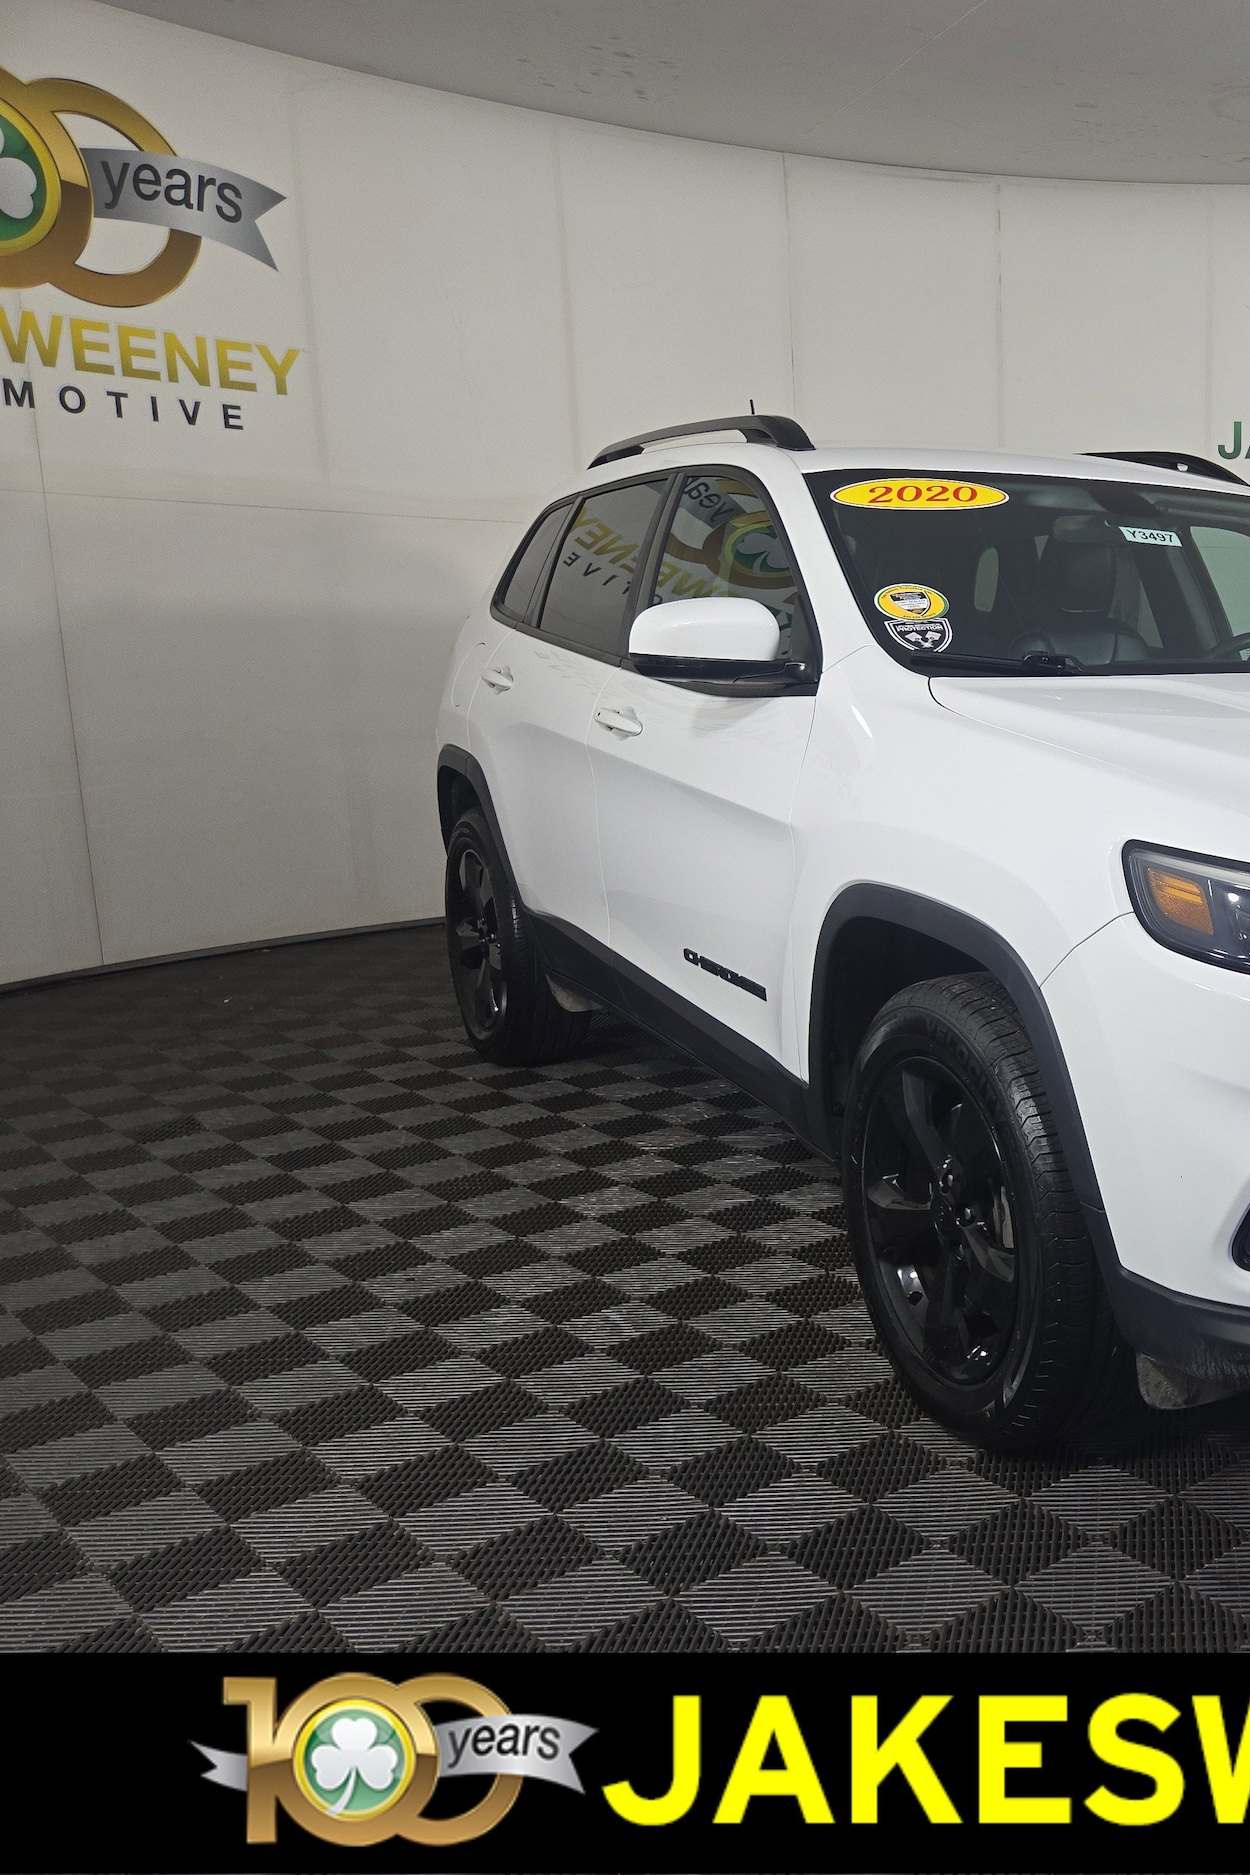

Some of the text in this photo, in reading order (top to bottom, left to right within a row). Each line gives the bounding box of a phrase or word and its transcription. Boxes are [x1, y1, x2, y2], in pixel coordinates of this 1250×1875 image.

[100, 161, 243, 223] years
[2, 378, 244, 430] MOTIVE
[868, 485, 978, 504] 2020
[1126, 529, 1173, 543] Y3497
